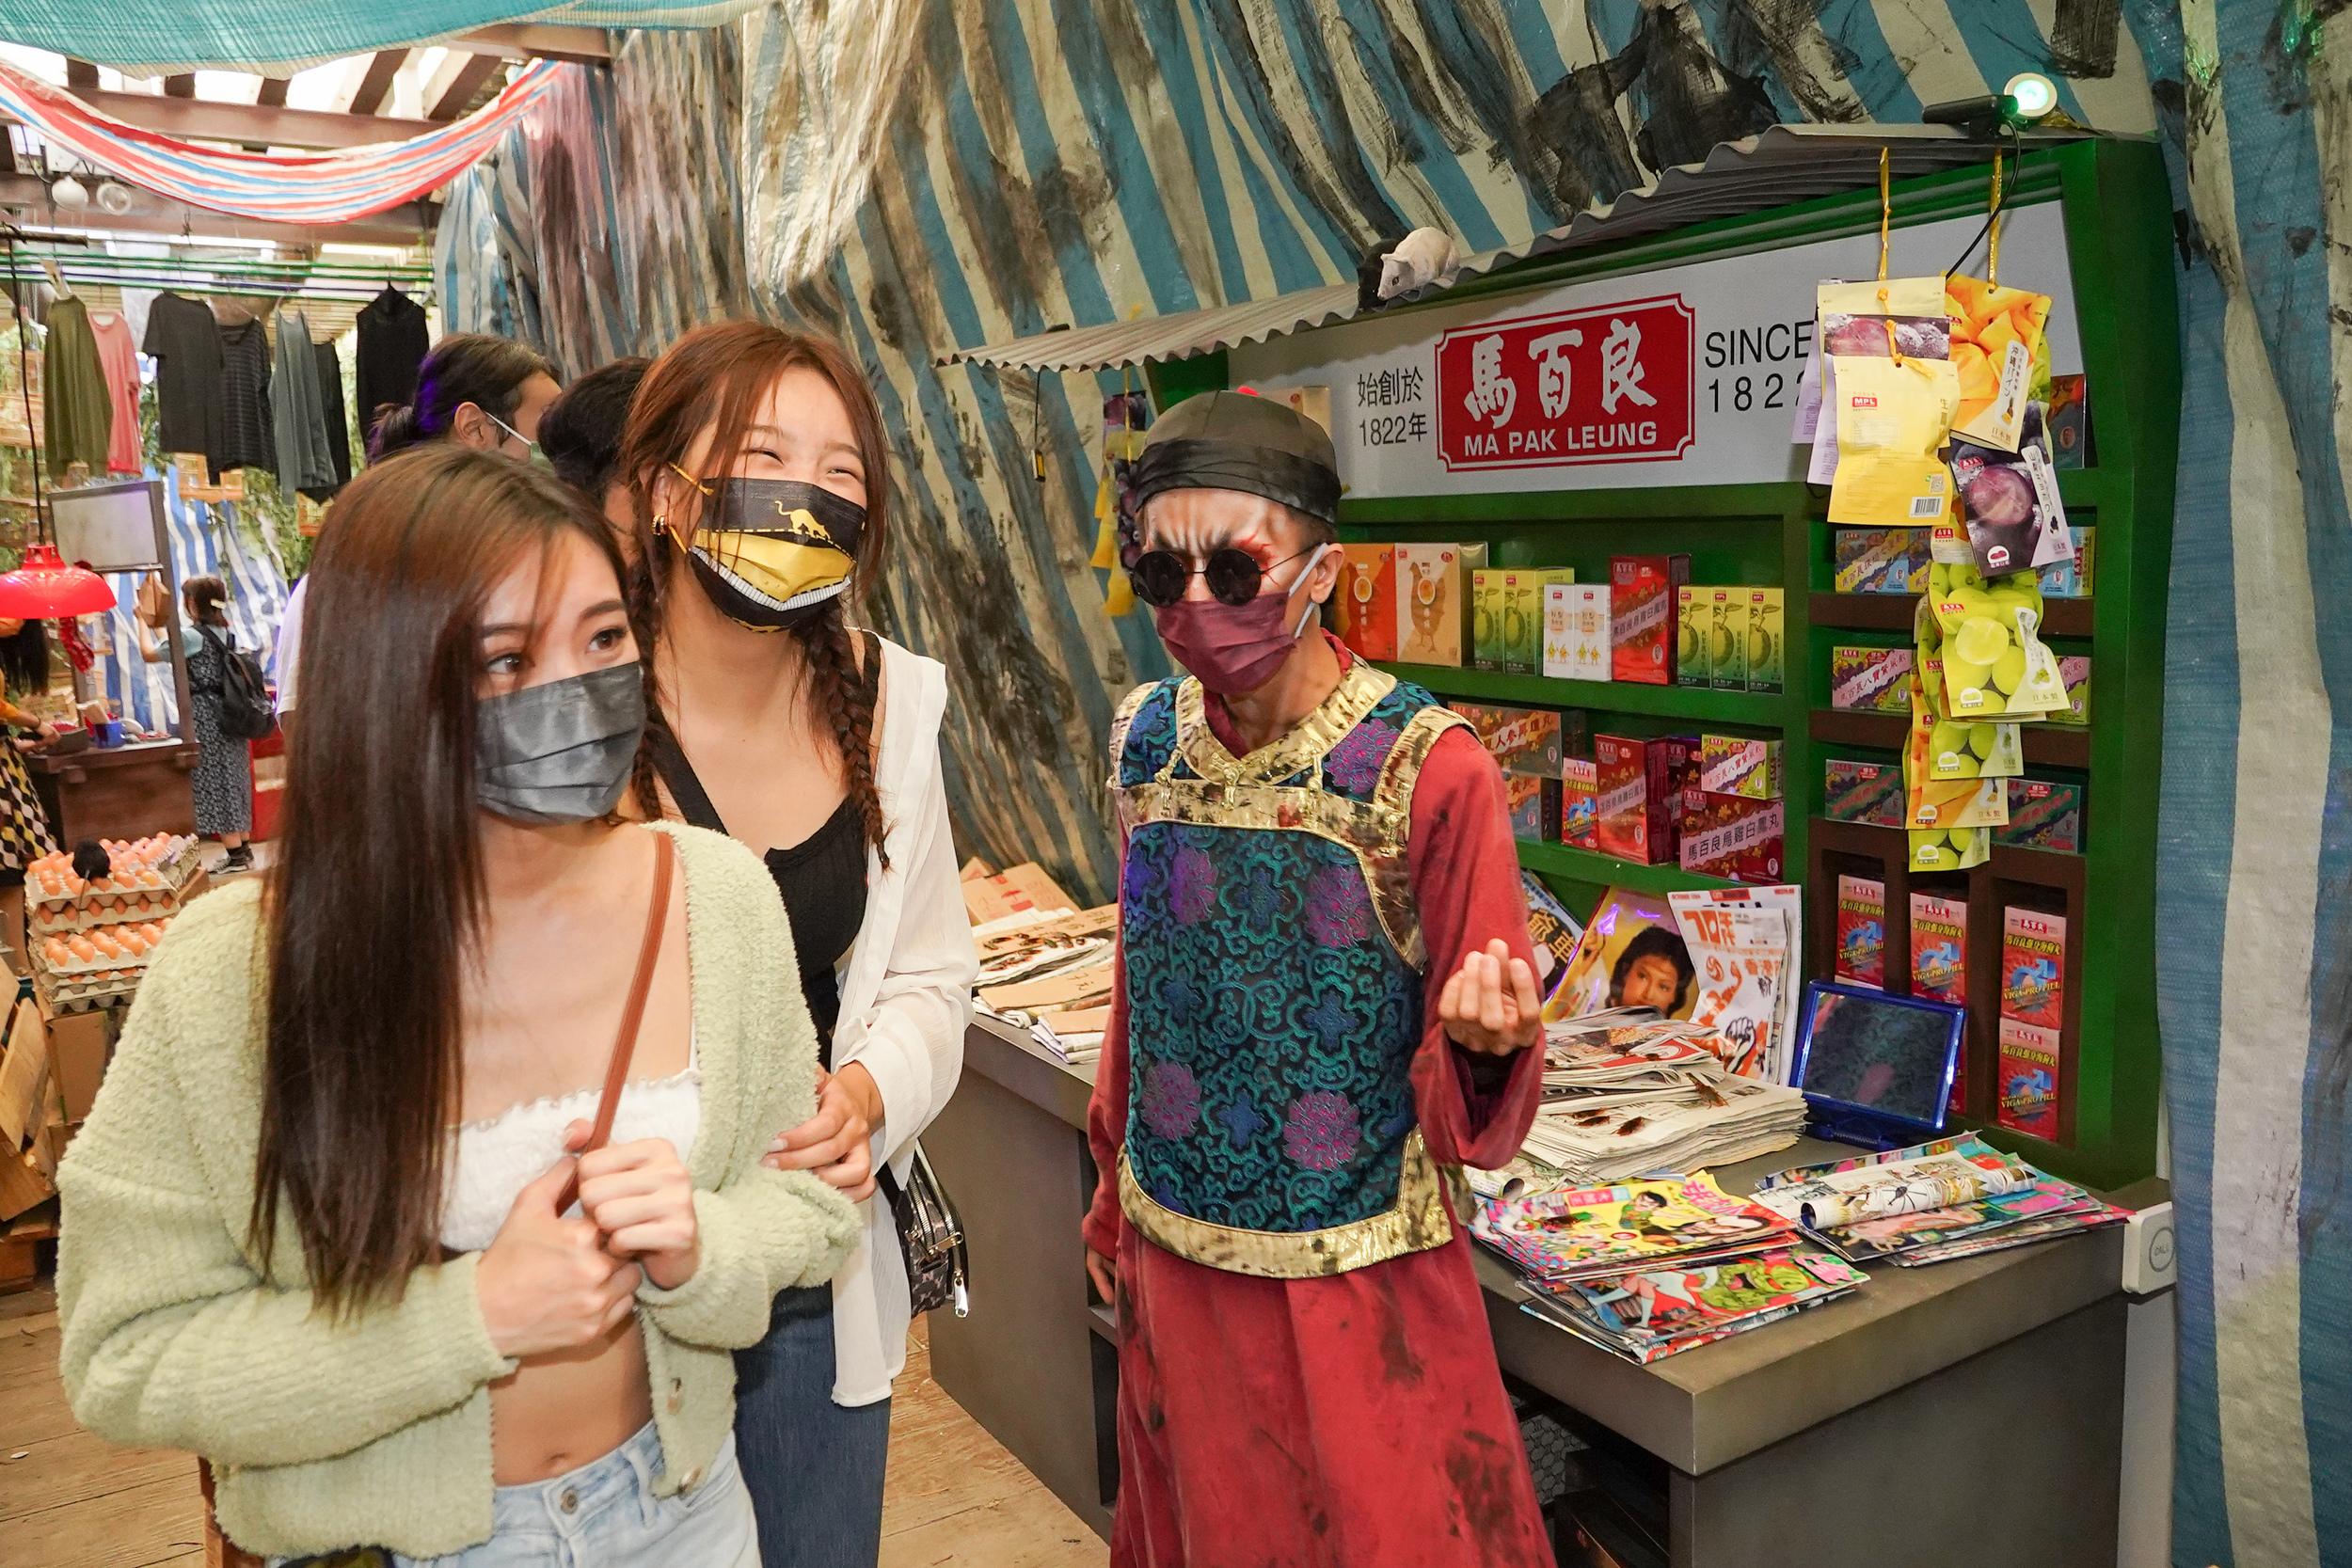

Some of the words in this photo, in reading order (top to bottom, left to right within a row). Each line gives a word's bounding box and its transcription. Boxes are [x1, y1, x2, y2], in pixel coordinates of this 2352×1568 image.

[1705, 321, 1815, 368] SINCE
[1358, 365, 1424, 407] 始創於
[1464, 318, 1658, 430] 馬百良
[1852, 397, 1877, 406] MPL
[1359, 411, 1428, 447] 1822年
[1464, 435, 1500, 457] MA
[1509, 431, 1558, 454] PAK
[1567, 420, 1658, 451] LEUNG
